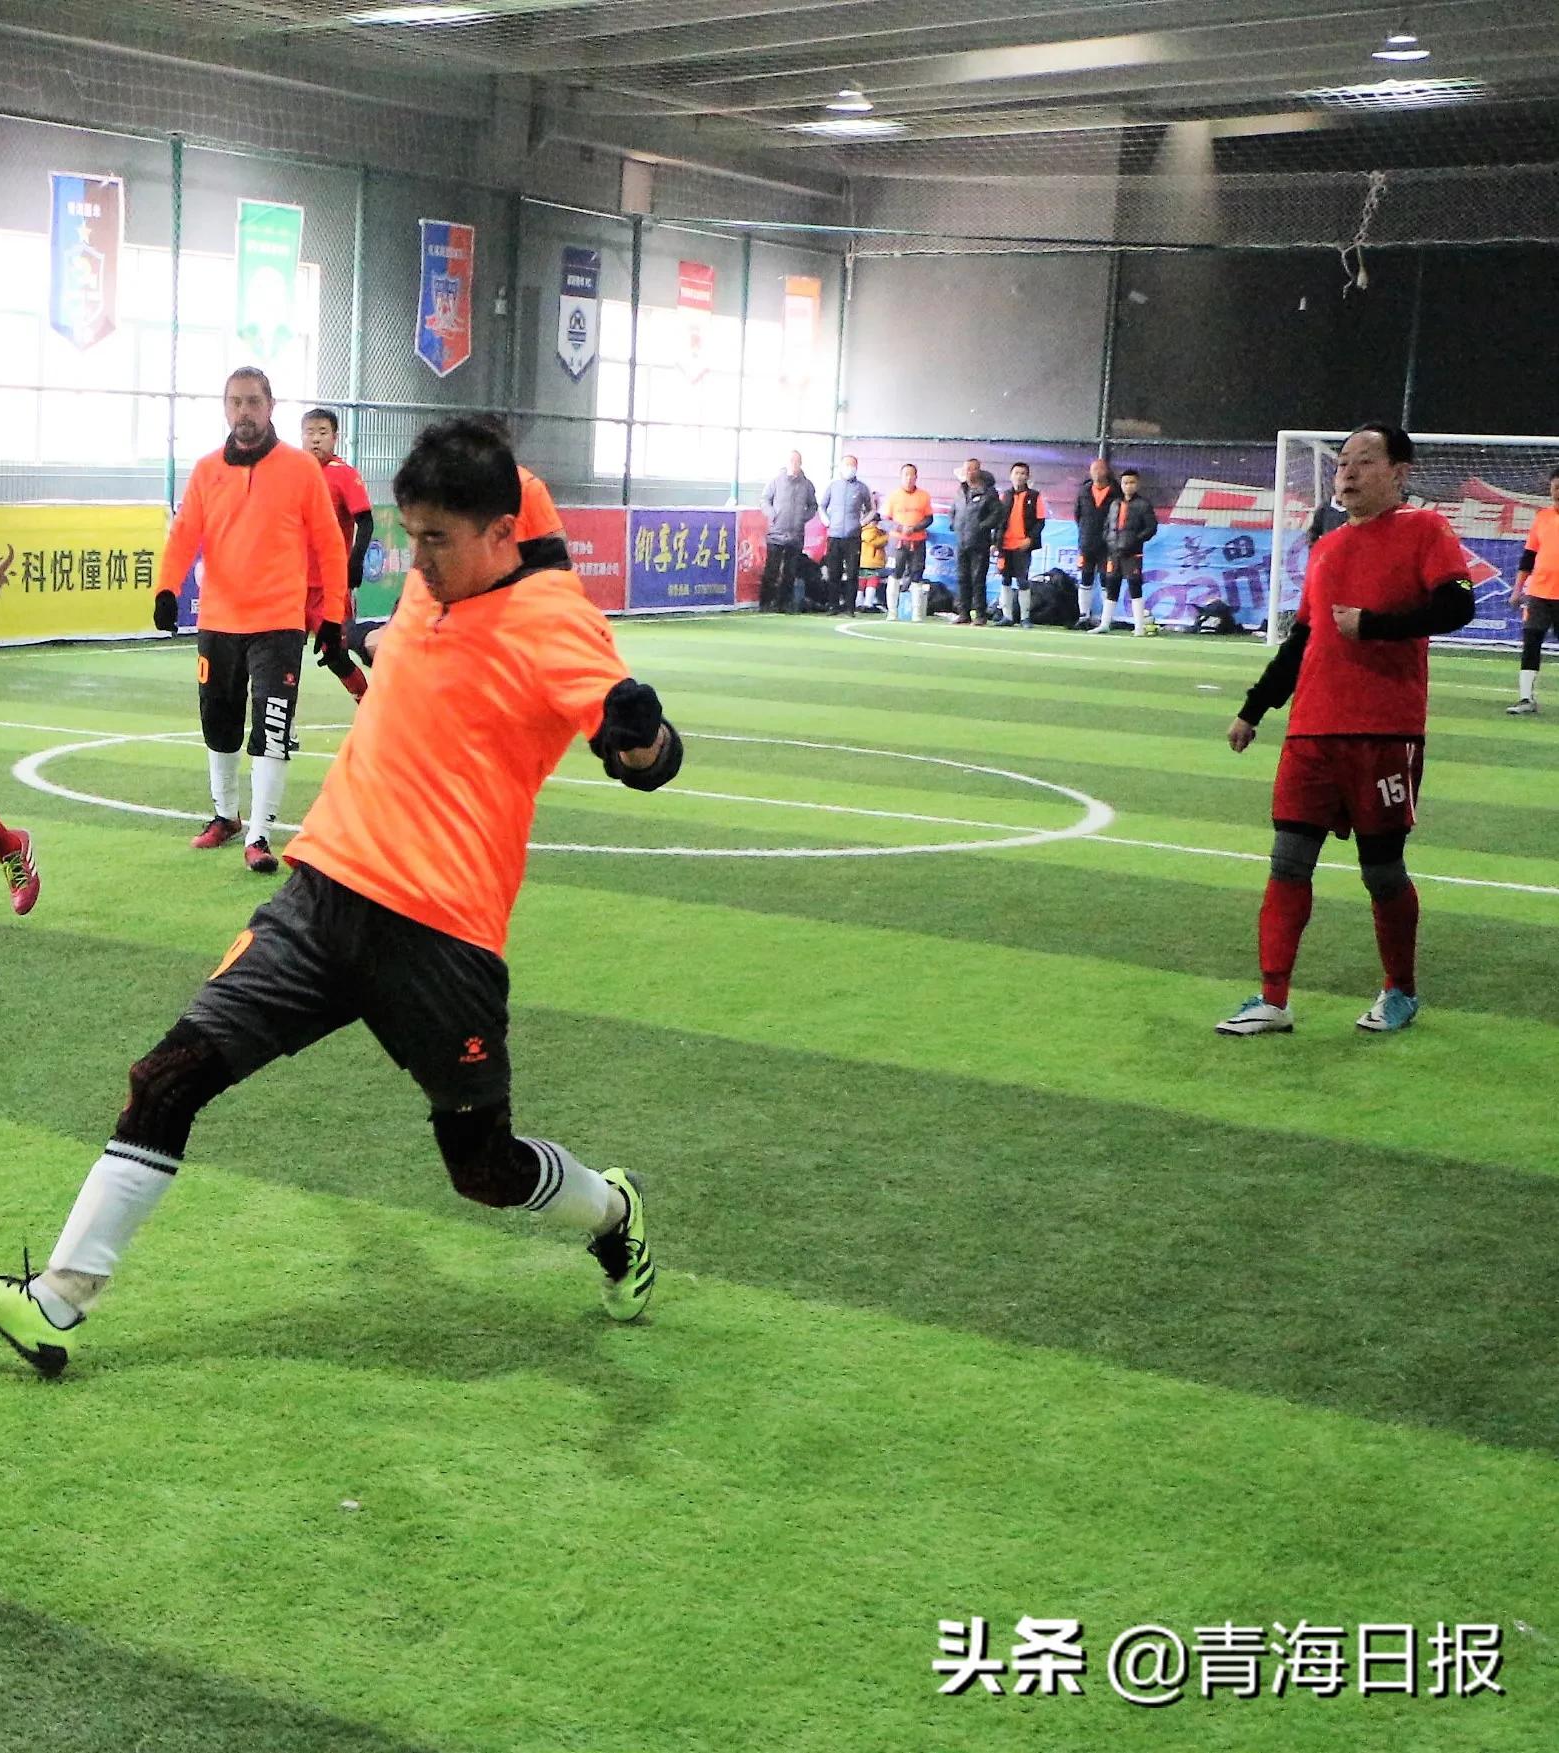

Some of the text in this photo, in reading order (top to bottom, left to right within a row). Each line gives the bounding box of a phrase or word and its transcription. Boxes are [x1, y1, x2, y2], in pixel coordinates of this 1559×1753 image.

[21, 549, 154, 592] 科悦憧体育
[1376, 773, 1407, 807] 15
